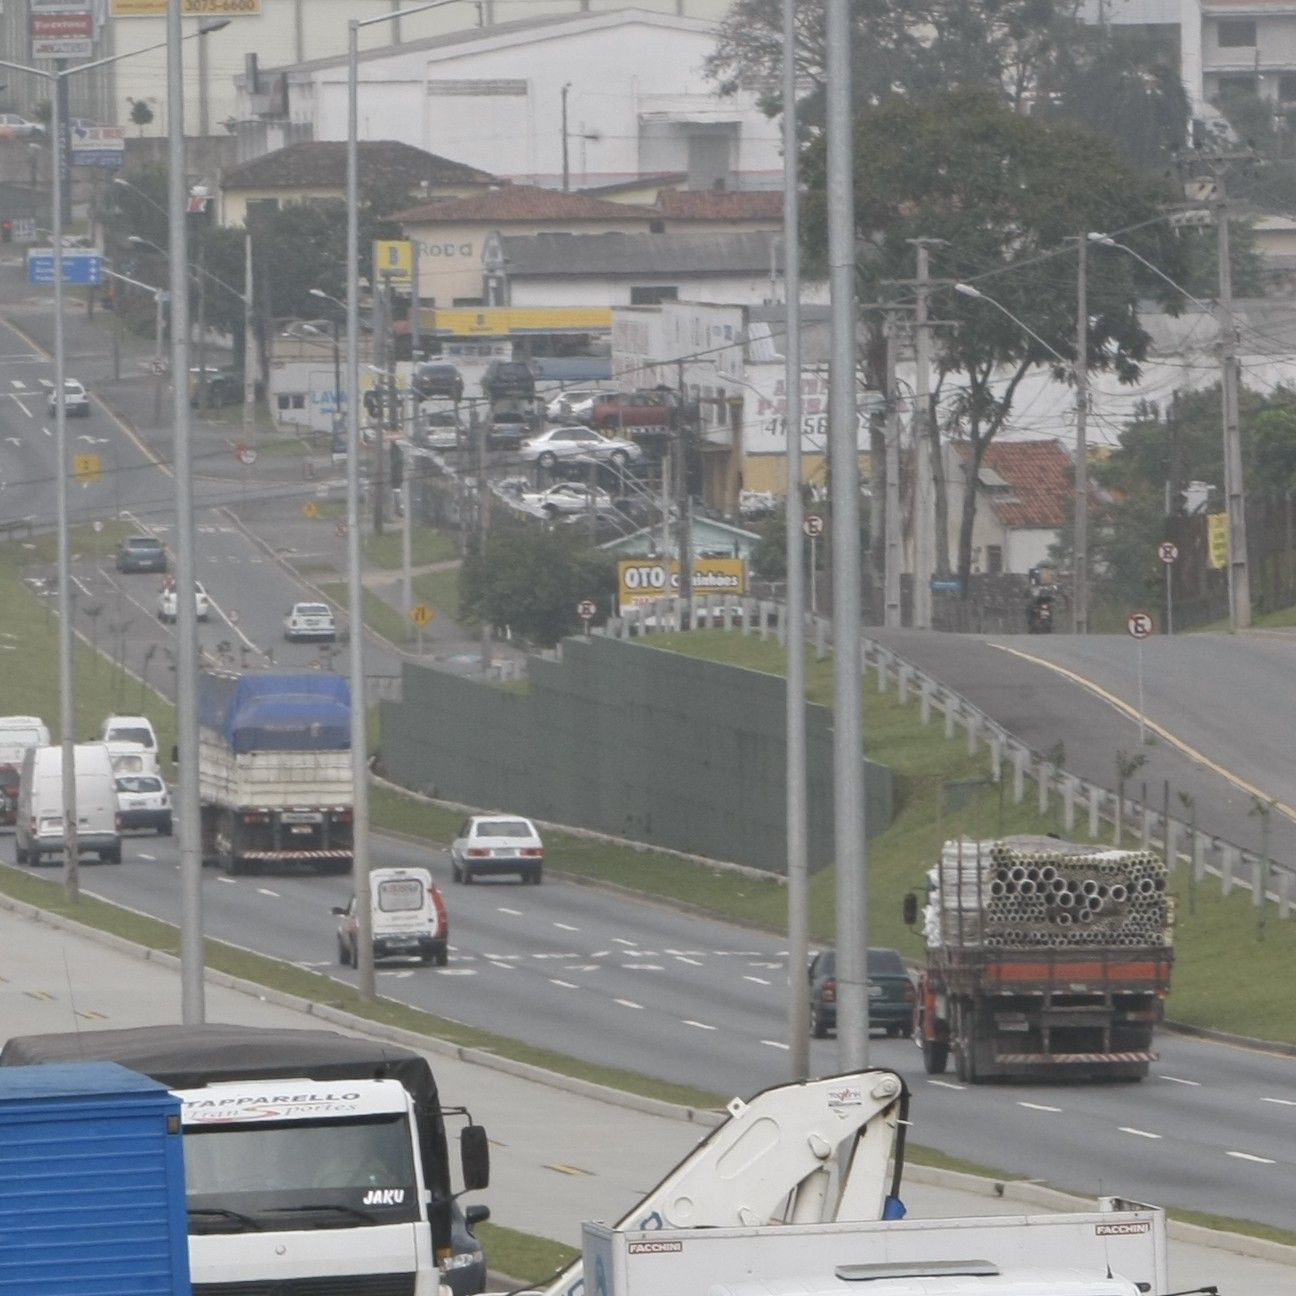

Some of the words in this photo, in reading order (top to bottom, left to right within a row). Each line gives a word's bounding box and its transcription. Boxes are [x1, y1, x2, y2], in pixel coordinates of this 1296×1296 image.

[625, 567, 665, 588] OTO
[186, 1093, 360, 1109] TAPPARELLO
[362, 1188, 405, 1206] JAKU
[1097, 1225, 1149, 1234] FACCHINI
[630, 1242, 682, 1253] FACCHINI
